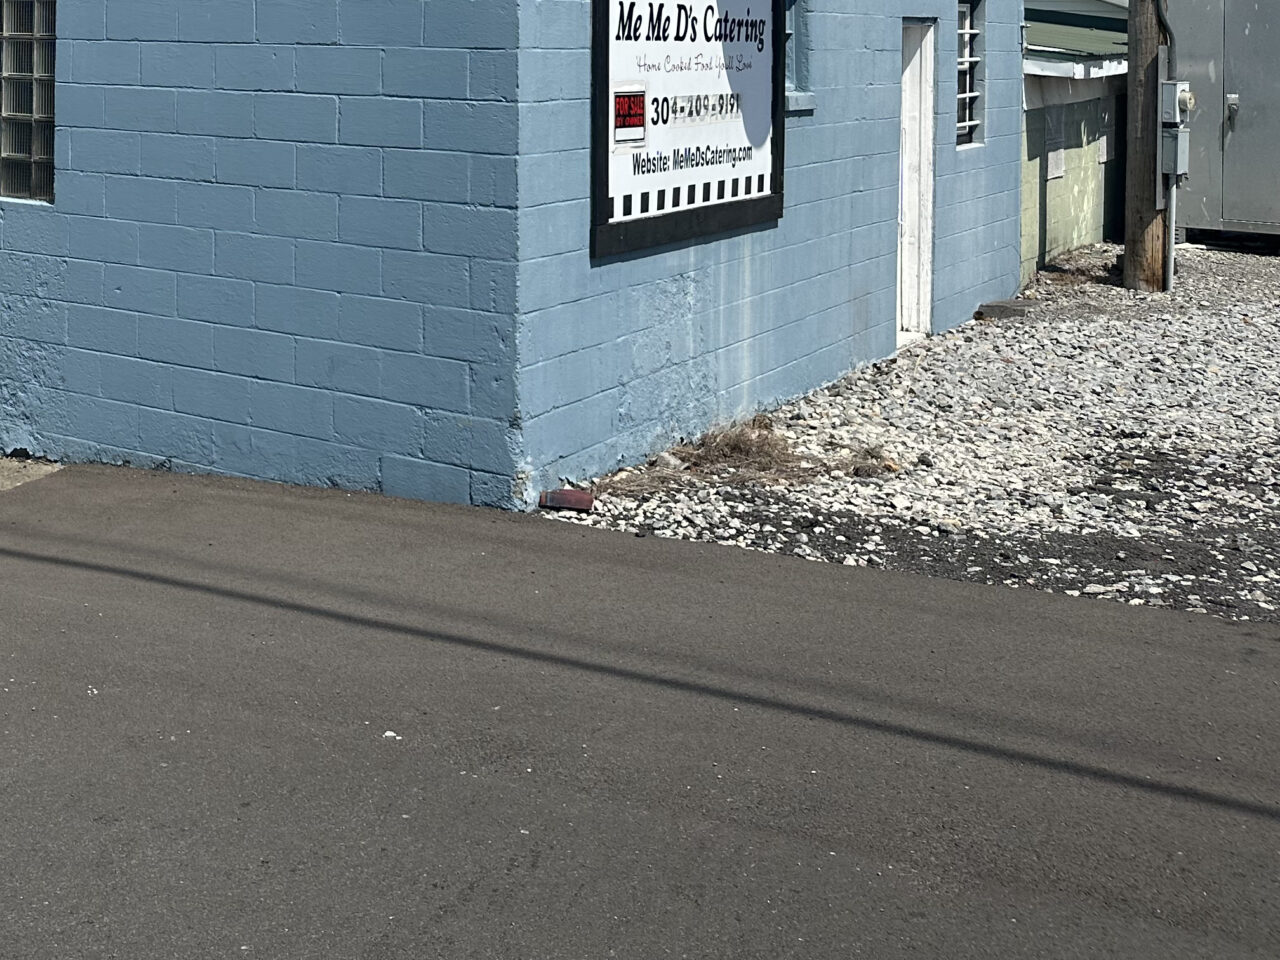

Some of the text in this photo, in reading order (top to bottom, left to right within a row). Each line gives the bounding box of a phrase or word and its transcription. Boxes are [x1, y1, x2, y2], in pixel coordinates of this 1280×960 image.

[615, 0, 766, 53] Me Me D's Catering
[664, 54, 691, 73] Cooked
[694, 52, 713, 72] Food
[615, 95, 644, 116] FOR SALE
[632, 143, 753, 176] Website: MeMeDsCatering.com
